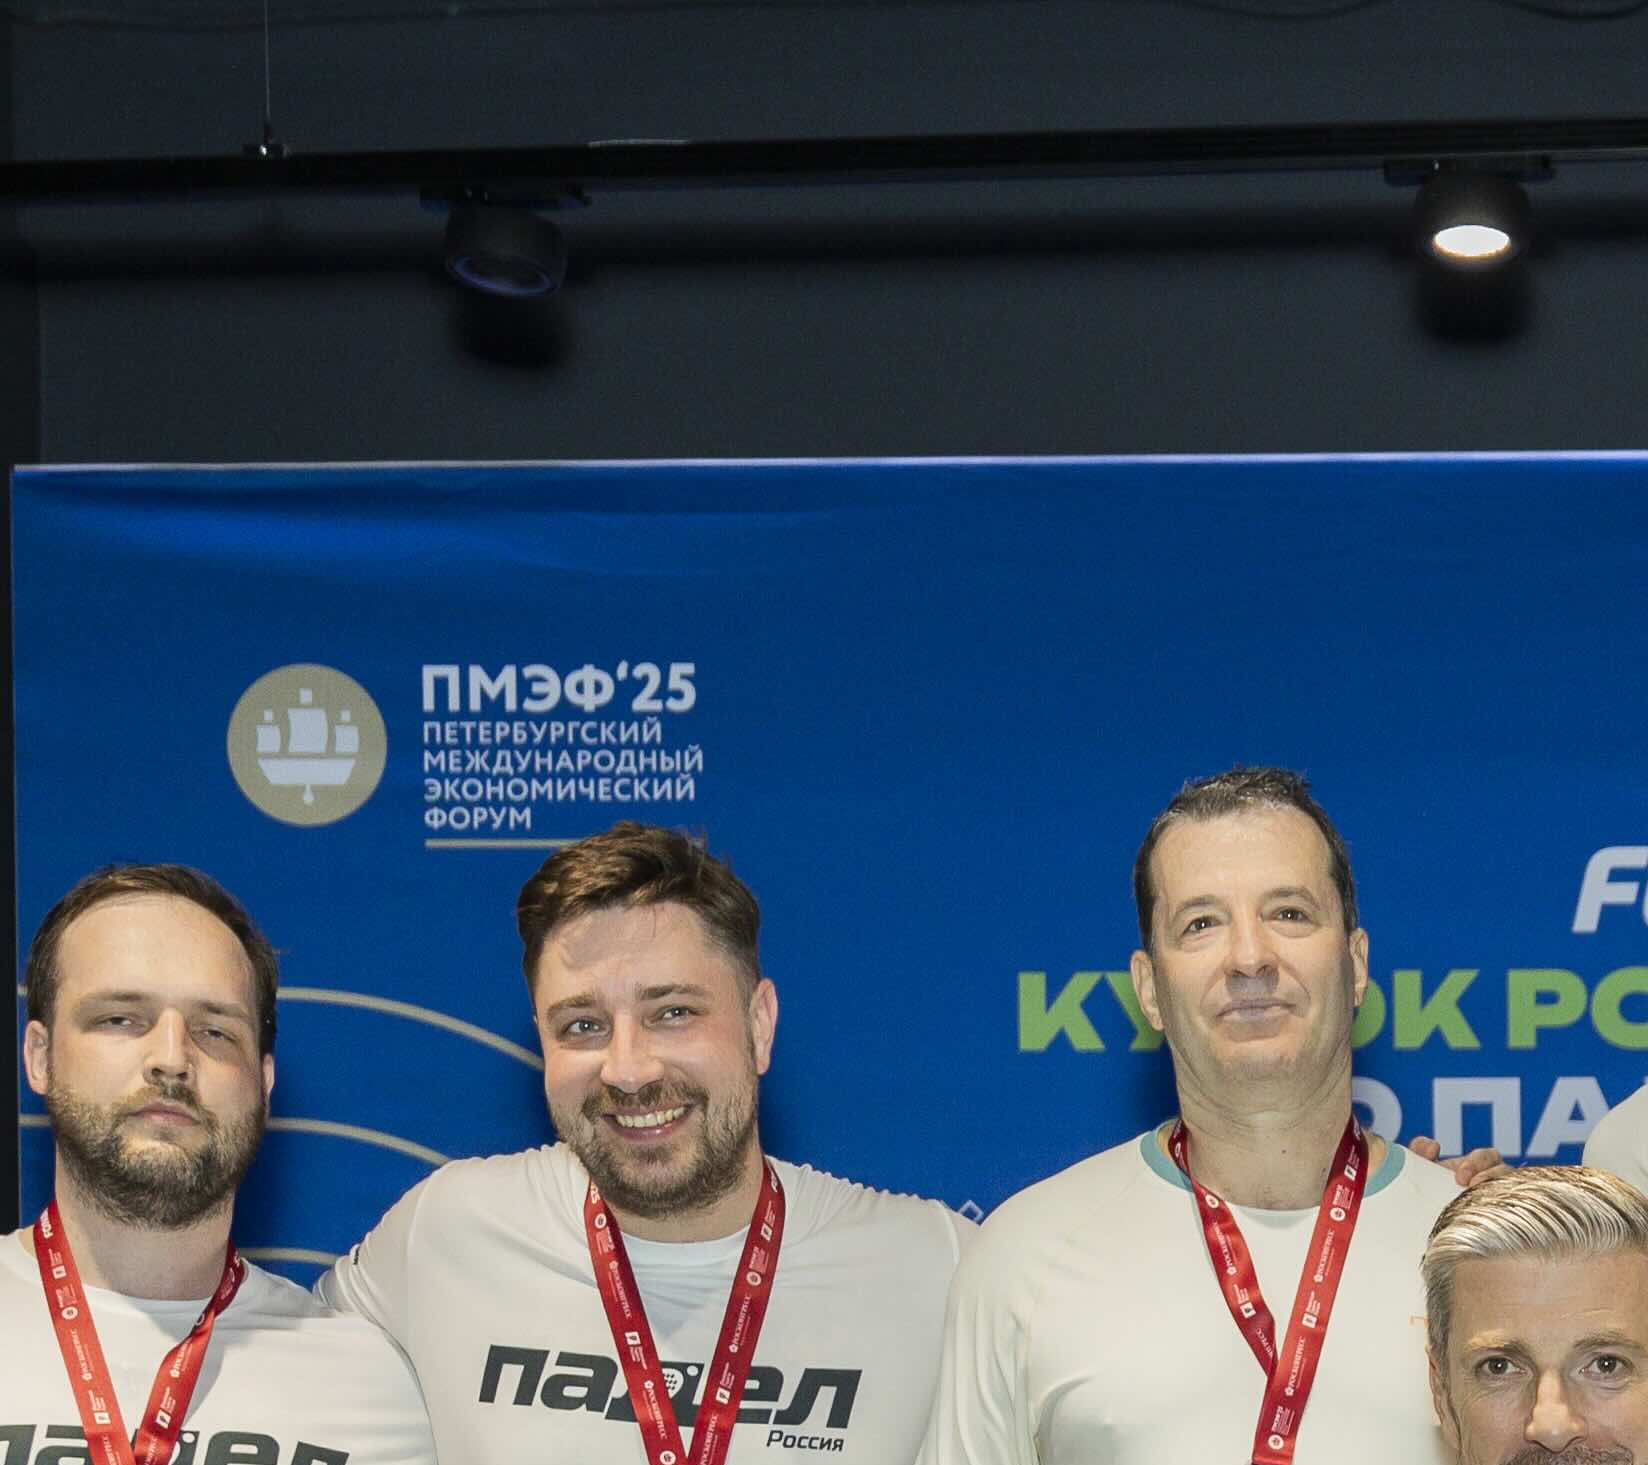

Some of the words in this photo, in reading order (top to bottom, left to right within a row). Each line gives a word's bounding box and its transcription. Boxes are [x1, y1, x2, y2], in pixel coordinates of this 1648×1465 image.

[422, 714, 664, 745] ПЕТЕРБУРГСКИЙ
[422, 744, 706, 775] МЕЖДУНАРОДНЫЙ
[422, 773, 698, 803] ЭКОНОМИЧЕСКИЙ
[423, 804, 534, 832] ФОРУМ
[765, 1430, 845, 1453] Россия
